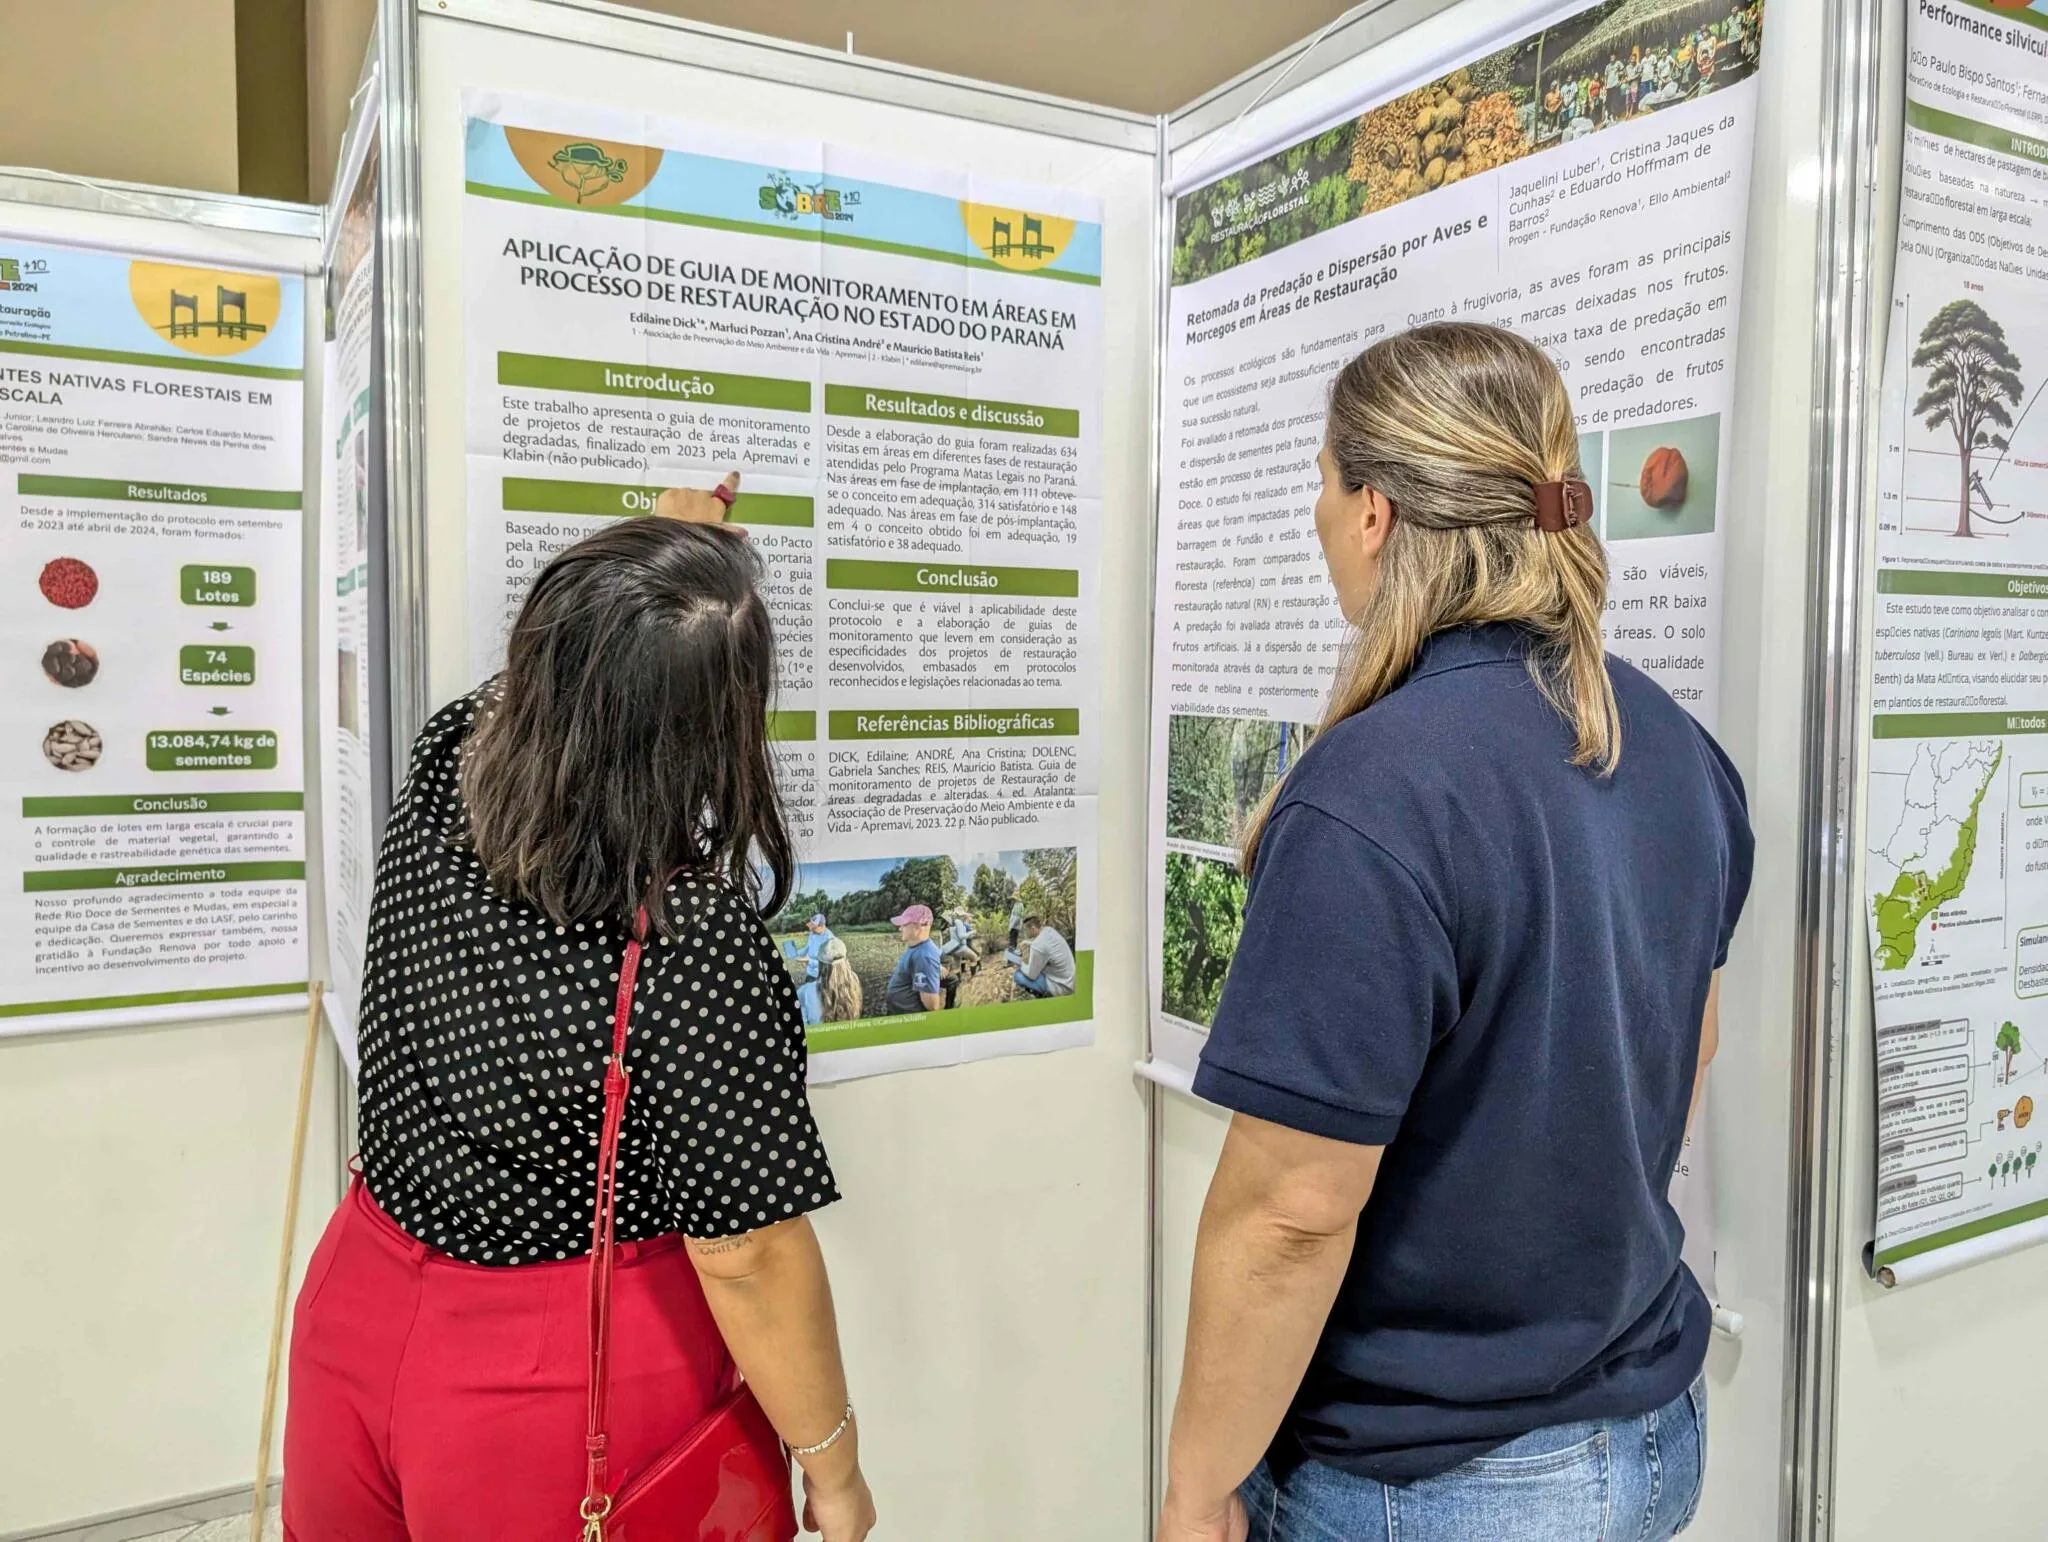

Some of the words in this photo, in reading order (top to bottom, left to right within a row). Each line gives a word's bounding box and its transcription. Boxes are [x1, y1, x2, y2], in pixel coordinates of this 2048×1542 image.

[1919, 0, 2002, 42] Performance
[1930, 56, 1956, 76] Paulo
[1959, 64, 1984, 86] Bispo
[1510, 171, 1558, 199] Jaquelini
[1610, 141, 1660, 165] Cristina
[1666, 123, 1714, 148] Jaques
[1719, 116, 1734, 130] da
[1559, 189, 1566, 199] e
[1570, 170, 1621, 196] Eduardo
[1626, 151, 1688, 178] Hoffmam
[1694, 143, 1710, 158] de
[1187, 299, 1239, 326] Retomada
[1243, 293, 1256, 307] da
[1260, 272, 1312, 302] Predação
[1317, 270, 1324, 281] e
[1329, 244, 1396, 278] Dispersão
[1402, 234, 1427, 257] por
[1433, 220, 1471, 243] Aves
[1478, 215, 1487, 228] e
[1407, 308, 1444, 327] Quanto
[1451, 301, 1457, 314] à
[1464, 287, 1521, 311] frugivoria,
[1529, 281, 1542, 294] as
[1550, 272, 1580, 288] aves
[1588, 260, 1628, 279] foram
[1638, 253, 1653, 267] as
[1663, 231, 1730, 264] principais
[502, 238, 641, 274] APLICAÇÃO
[647, 255, 675, 276] DE
[680, 260, 736, 284] GUIA
[742, 268, 768, 288] DE
[773, 272, 958, 313] MONITORAMENTO
[962, 298, 988, 318] EM
[992, 299, 1047, 325] ÁREAS
[1052, 311, 1076, 330] EM
[521, 266, 642, 298] PROCESSO
[647, 281, 675, 302] DE
[681, 285, 839, 322] RESTAURAÇÃO
[844, 305, 874, 325] NO
[880, 310, 954, 335] ESTADO
[959, 321, 986, 340] DO
[991, 325, 1064, 350] PARANÁ
[1186, 321, 1236, 345] Morcegos
[1239, 314, 1255, 328] em
[1259, 302, 1290, 322] Áreas
[1295, 295, 1309, 310] de
[1314, 268, 1397, 304] Restauração
[1574, 325, 1602, 340] taxa
[1610, 318, 1626, 332] de
[1634, 303, 1700, 331] predação
[1708, 295, 1726, 310] em
[630, 312, 670, 326] Edilaine
[710, 321, 748, 334] Marluci
[793, 330, 812, 341] Ana
[814, 332, 850, 346] Cristina
[934, 347, 962, 359] Batista
[49, 372, 125, 391] NATIVAS
[133, 380, 241, 402] FLORESTAIS
[248, 391, 272, 405] EM
[605, 368, 714, 397] Introdução
[503, 396, 529, 410] Este
[534, 400, 588, 415] trabalho
[592, 407, 652, 420] apresenta
[656, 412, 665, 421] o
[670, 412, 694, 426] guia
[699, 413, 714, 425] de
[718, 417, 810, 434] monitoramento
[866, 394, 955, 418] Resultados
[959, 408, 967, 419] e
[971, 404, 1044, 427] discussão
[1182, 418, 1198, 427] sua
[1200, 409, 1231, 425] sucessão
[1233, 402, 1260, 416] natural.
[826, 424, 860, 438] Desde
[865, 430, 871, 439] a
[876, 428, 932, 446] elaboração
[937, 434, 950, 446] do
[955, 438, 974, 450] guia
[979, 437, 1008, 451] foram
[1012, 442, 1057, 455] realizadas
[1060, 446, 1076, 457] 634
[128, 485, 207, 502] Resultados
[20, 505, 54, 515] Desde
[66, 509, 148, 522] implementação
[151, 512, 164, 522] do
[167, 516, 216, 525] protocolo
[237, 520, 282, 528] setembro
[203, 571, 231, 584] 189
[916, 569, 998, 587] Conclusão
[1623, 566, 1646, 580] são
[1660, 563, 1707, 579] viáveis,
[196, 588, 239, 602] Lotes
[828, 598, 884, 611] Conclui-se
[892, 603, 912, 614] que
[920, 601, 926, 612] é
[933, 602, 960, 613] viável
[969, 605, 973, 614] a
[980, 603, 1045, 616] aplicabilidade
[1052, 605, 1077, 616] deste
[1886, 602, 1903, 614] Este
[1905, 603, 1932, 614] estudo
[1933, 605, 1949, 614] teve
[1951, 606, 1972, 615] como
[1973, 604, 2000, 618] objetivo
[2002, 606, 2029, 616] analisar
[2030, 609, 2035, 617] o
[206, 651, 227, 663] 74
[182, 670, 251, 684] Espécies
[1170, 702, 1214, 713] viabilidade
[1216, 704, 1230, 714] das
[1232, 706, 1269, 717] sementes.
[857, 714, 949, 732] Referências
[954, 713, 1054, 733] Bibliográficas
[150, 734, 231, 749] 13.084,74
[234, 734, 253, 749] kg
[256, 736, 275, 747] de
[176, 754, 251, 766] sementes
[867, 750, 908, 762] Edilaine;
[961, 749, 980, 758] Ana
[987, 747, 1026, 758] Cristina;
[133, 797, 207, 810] Conclusão
[115, 868, 225, 886] Agradecimento
